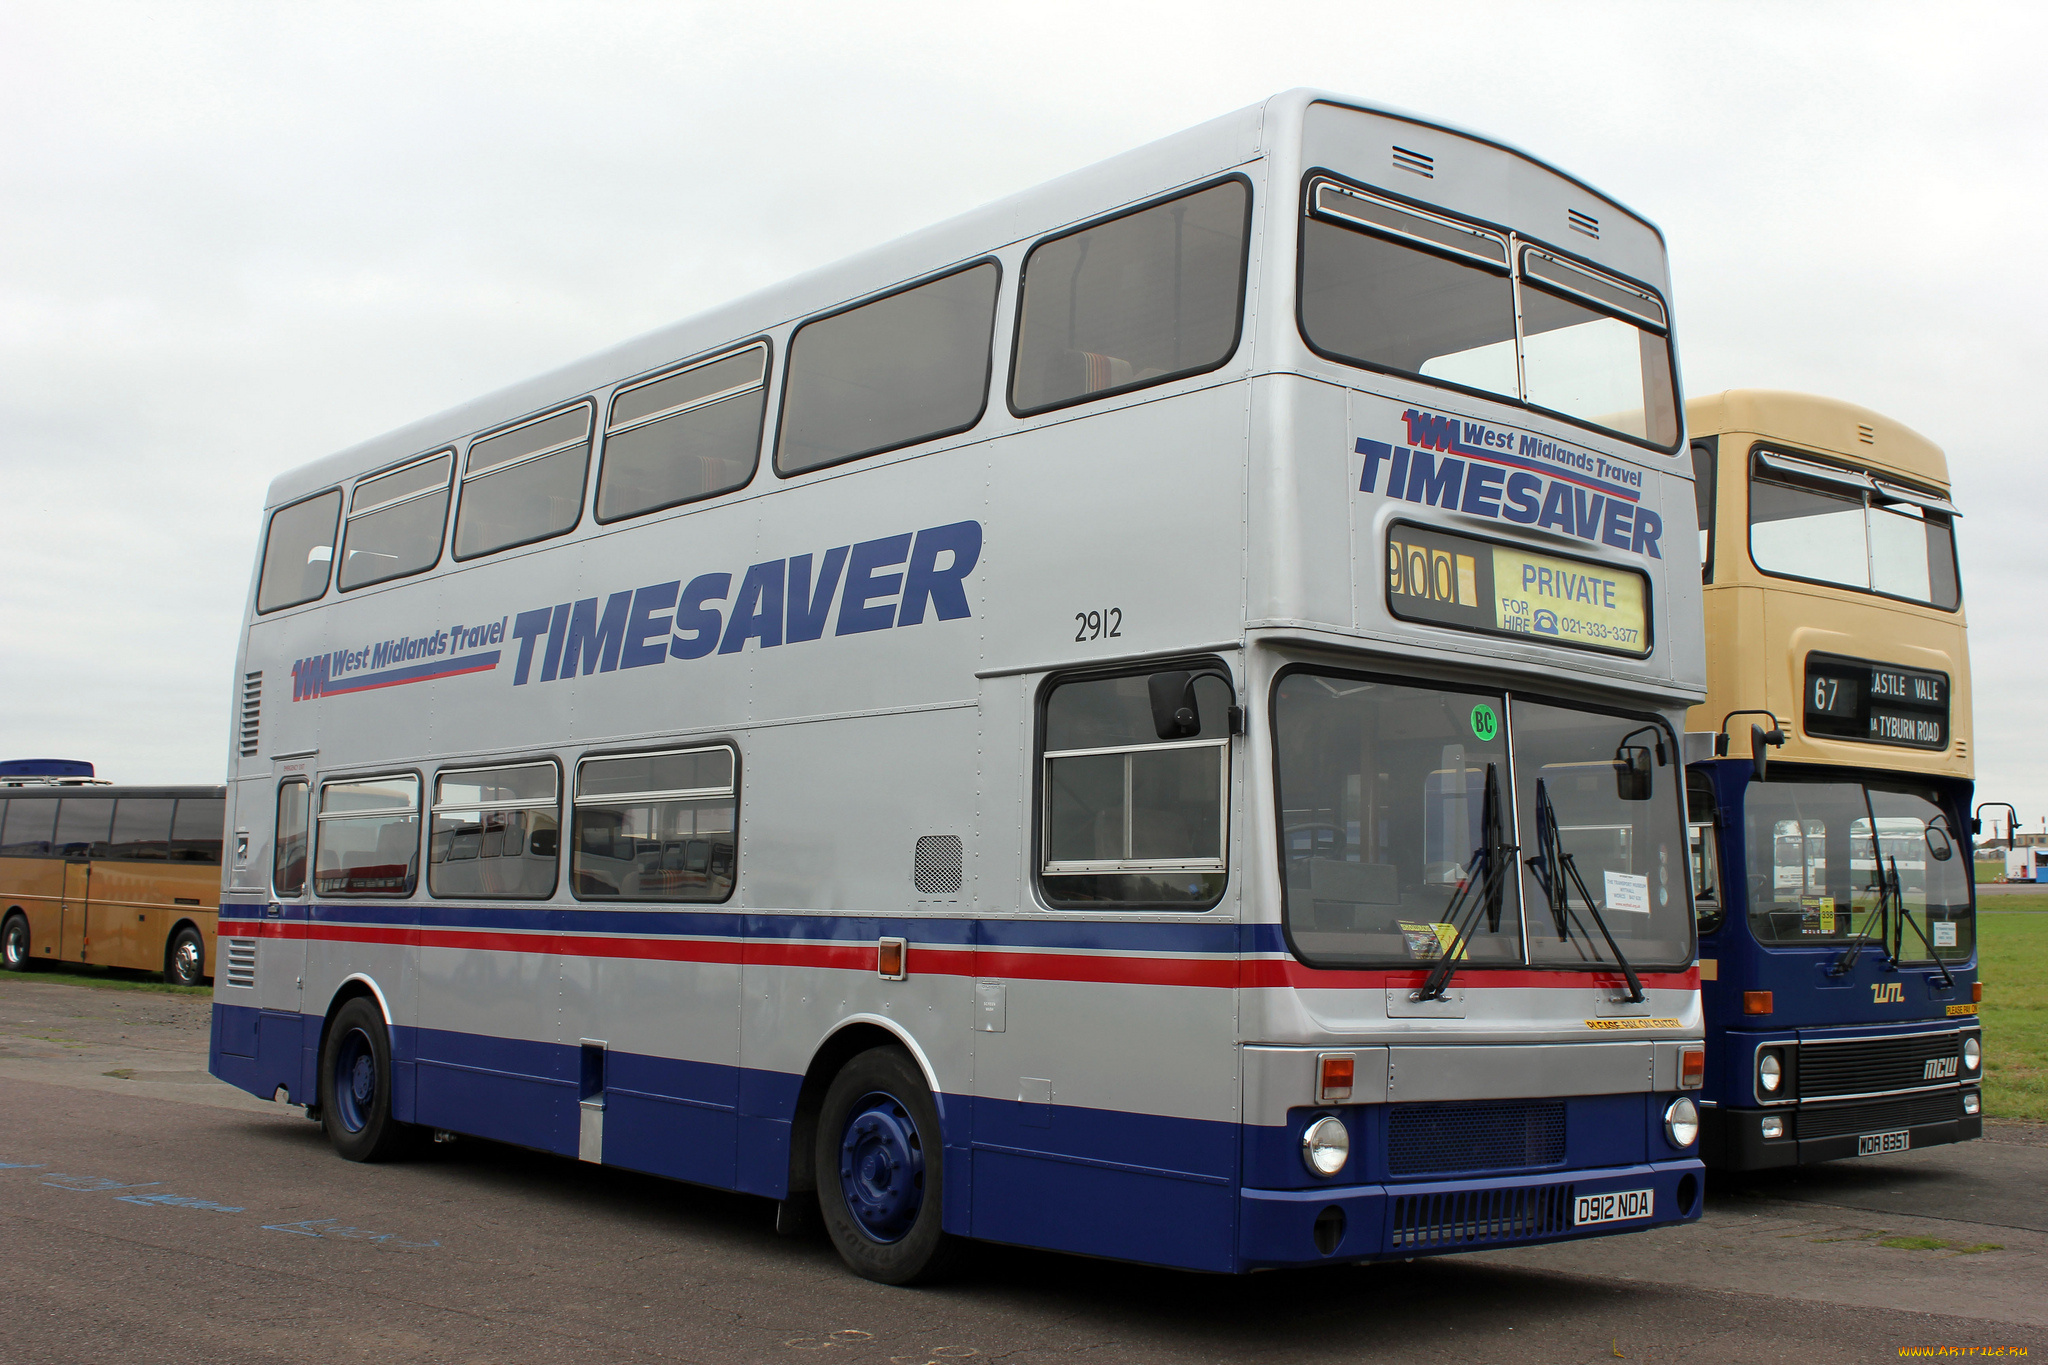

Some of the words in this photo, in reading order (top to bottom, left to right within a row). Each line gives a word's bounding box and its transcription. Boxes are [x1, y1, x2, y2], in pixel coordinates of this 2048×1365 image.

[1463, 421, 1514, 449] West
[1518, 435, 1594, 472] Midlands
[1596, 457, 1643, 488] Travel
[1354, 436, 1664, 560] TIMESAVER
[1522, 563, 1616, 609] PRIVATE
[512, 519, 983, 687] TIMESAVER
[1502, 597, 1529, 616] FOR
[1074, 606, 1123, 643] 2912
[1503, 614, 1531, 634] HIRE
[1561, 616, 1639, 644] 021-333-3377
[332, 644, 371, 678] West
[370, 629, 449, 670] Midlands
[449, 615, 510, 656] Travel
[1814, 677, 1839, 711] 67
[1871, 673, 1906, 697] ASTLE
[1914, 678, 1939, 701] VALE
[1475, 710, 1493, 734] BC
[1879, 715, 1915, 740] TYBURN
[1917, 720, 1940, 743] ROAD
[1586, 1021, 1620, 1030] PLEASE
[1638, 1019, 1654, 1029] ON
[1653, 1018, 1681, 1029] ENTRY
[1923, 1056, 1959, 1080] MCW
[1859, 1135, 1881, 1155] WDA
[1882, 1131, 1909, 1152] 835T
[1579, 1194, 1615, 1223] D912
[1617, 1191, 1649, 1219] NDA
